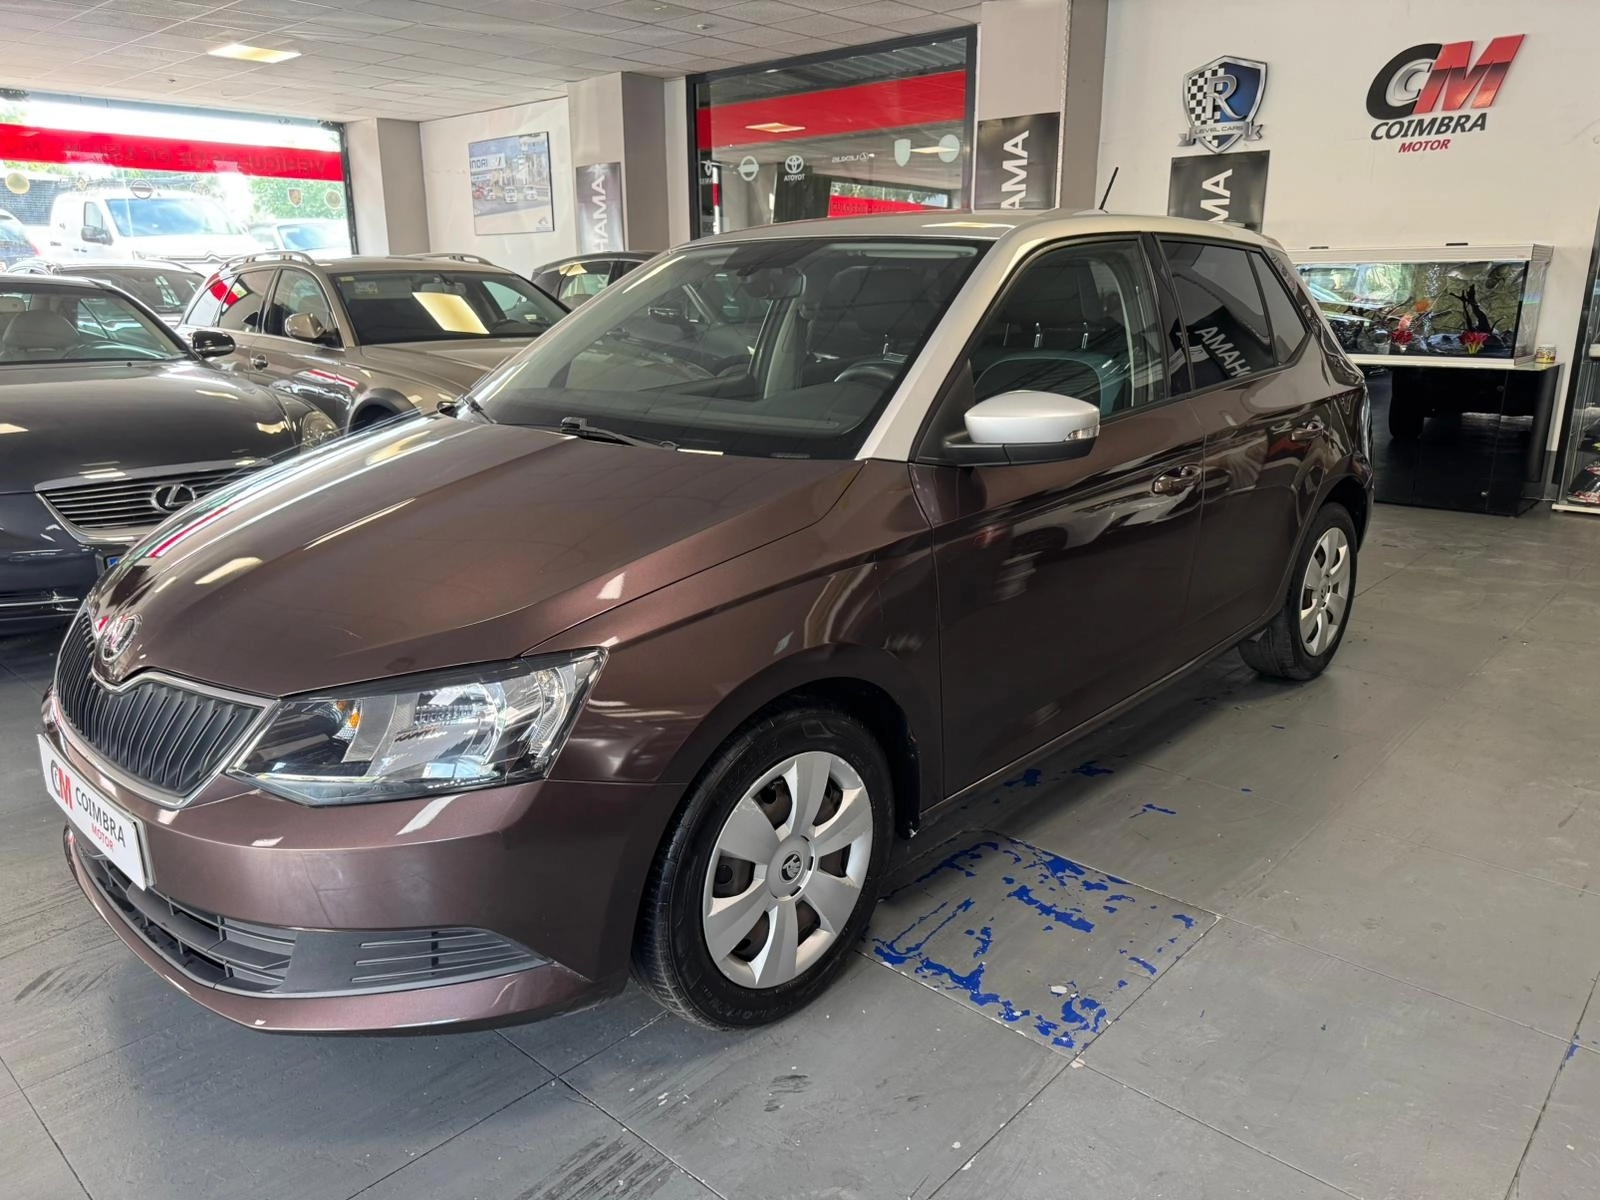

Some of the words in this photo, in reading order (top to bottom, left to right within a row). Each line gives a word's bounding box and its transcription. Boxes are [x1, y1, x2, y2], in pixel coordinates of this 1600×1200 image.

[1194, 126, 1221, 135] LEVEL
[1221, 124, 1244, 132] CARS
[1370, 112, 1488, 141] COIMBRA
[1398, 138, 1452, 153] MOTOR
[75, 786, 126, 848] COIMBRA
[91, 823, 114, 853] MOTOR
